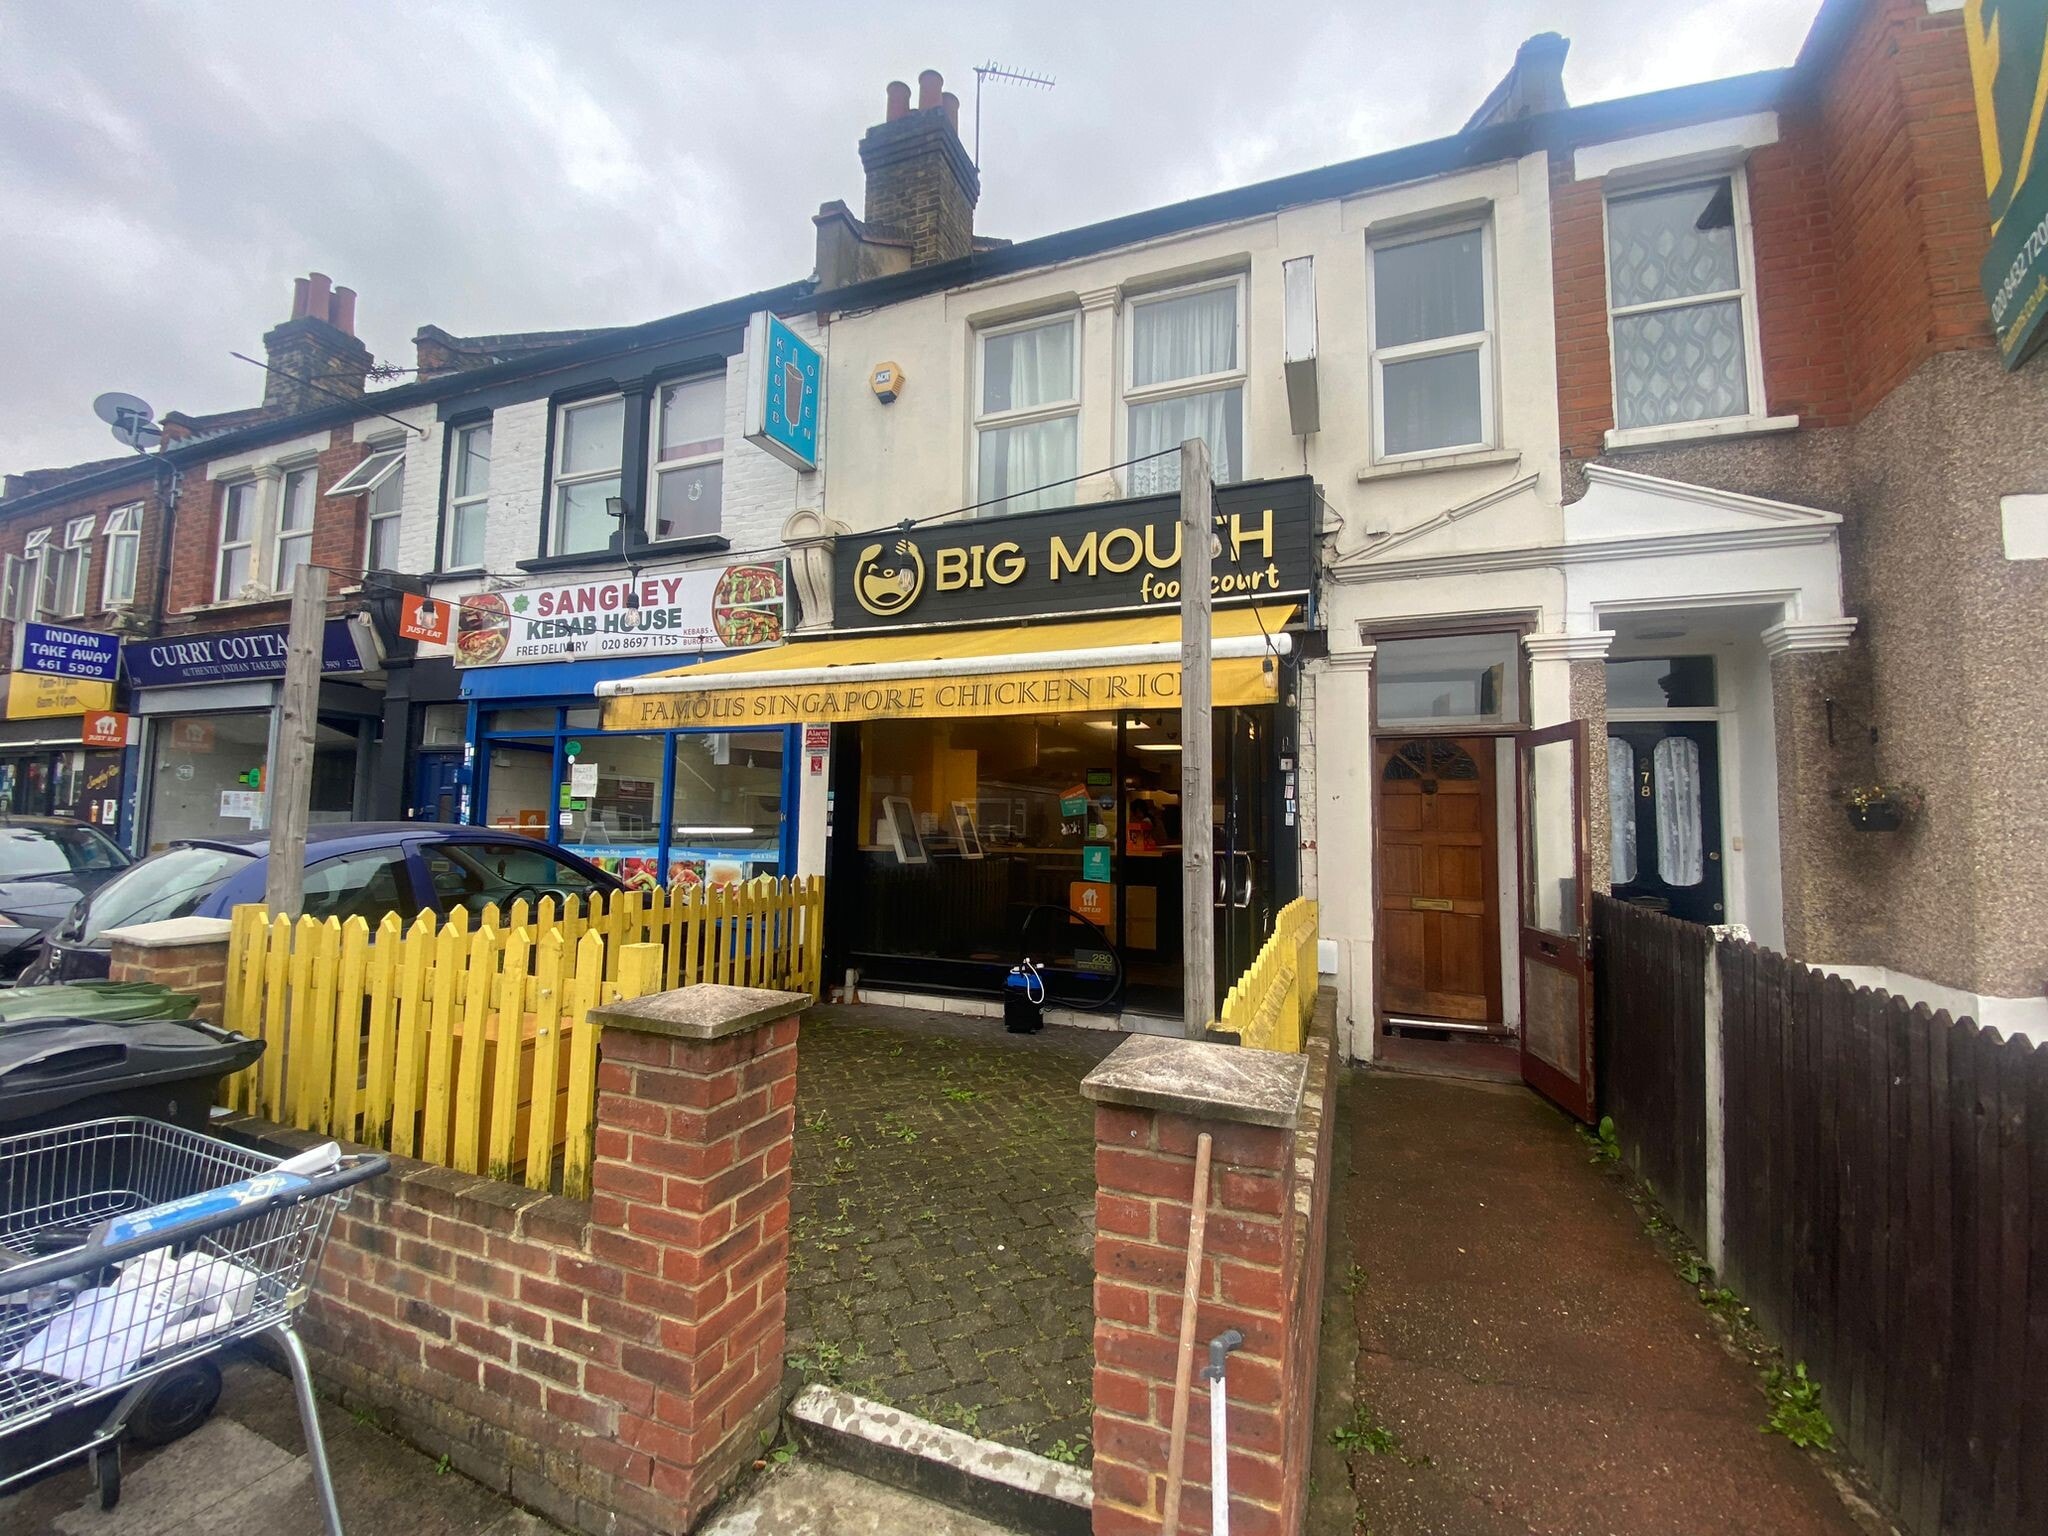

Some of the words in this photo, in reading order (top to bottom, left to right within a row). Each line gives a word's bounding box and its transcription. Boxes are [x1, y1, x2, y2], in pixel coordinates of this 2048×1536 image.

[772, 337, 785, 424] KEBAB
[876, 371, 890, 383] ADT
[804, 365, 814, 440] OPEN
[936, 541, 1026, 592] BIG
[1050, 509, 1273, 581] MOUH
[1140, 572, 1182, 604] foo
[1209, 562, 1280, 595] court
[537, 577, 683, 617] SANGLEY
[406, 624, 427, 635] JUST
[426, 628, 443, 639] EAT
[526, 615, 597, 641] KEBAB
[683, 627, 709, 636] KEBABS
[45, 629, 100, 648] INDIAN
[516, 644, 539, 657] FREE
[540, 640, 589, 656] DELIVRY
[601, 638, 621, 651] 020
[623, 636, 649, 649] 8697
[653, 634, 678, 647] 1155
[30, 642, 68, 659] TAKE
[71, 648, 112, 664] AWAY
[150, 640, 214, 668] CURRY
[218, 633, 290, 661] COTTA
[37, 658, 61, 671] 461
[68, 662, 103, 676] 5909
[182, 664, 221, 677] AUTHENTIC
[221, 661, 250, 674] INDIAN
[250, 658, 287, 672] TAKEAWA
[640, 695, 746, 722] FAMOUS
[753, 686, 926, 718] SINGAPORE
[936, 676, 1094, 708] CHICKEN
[1106, 671, 1182, 699] RIC
[1092, 953, 1113, 963] 280
